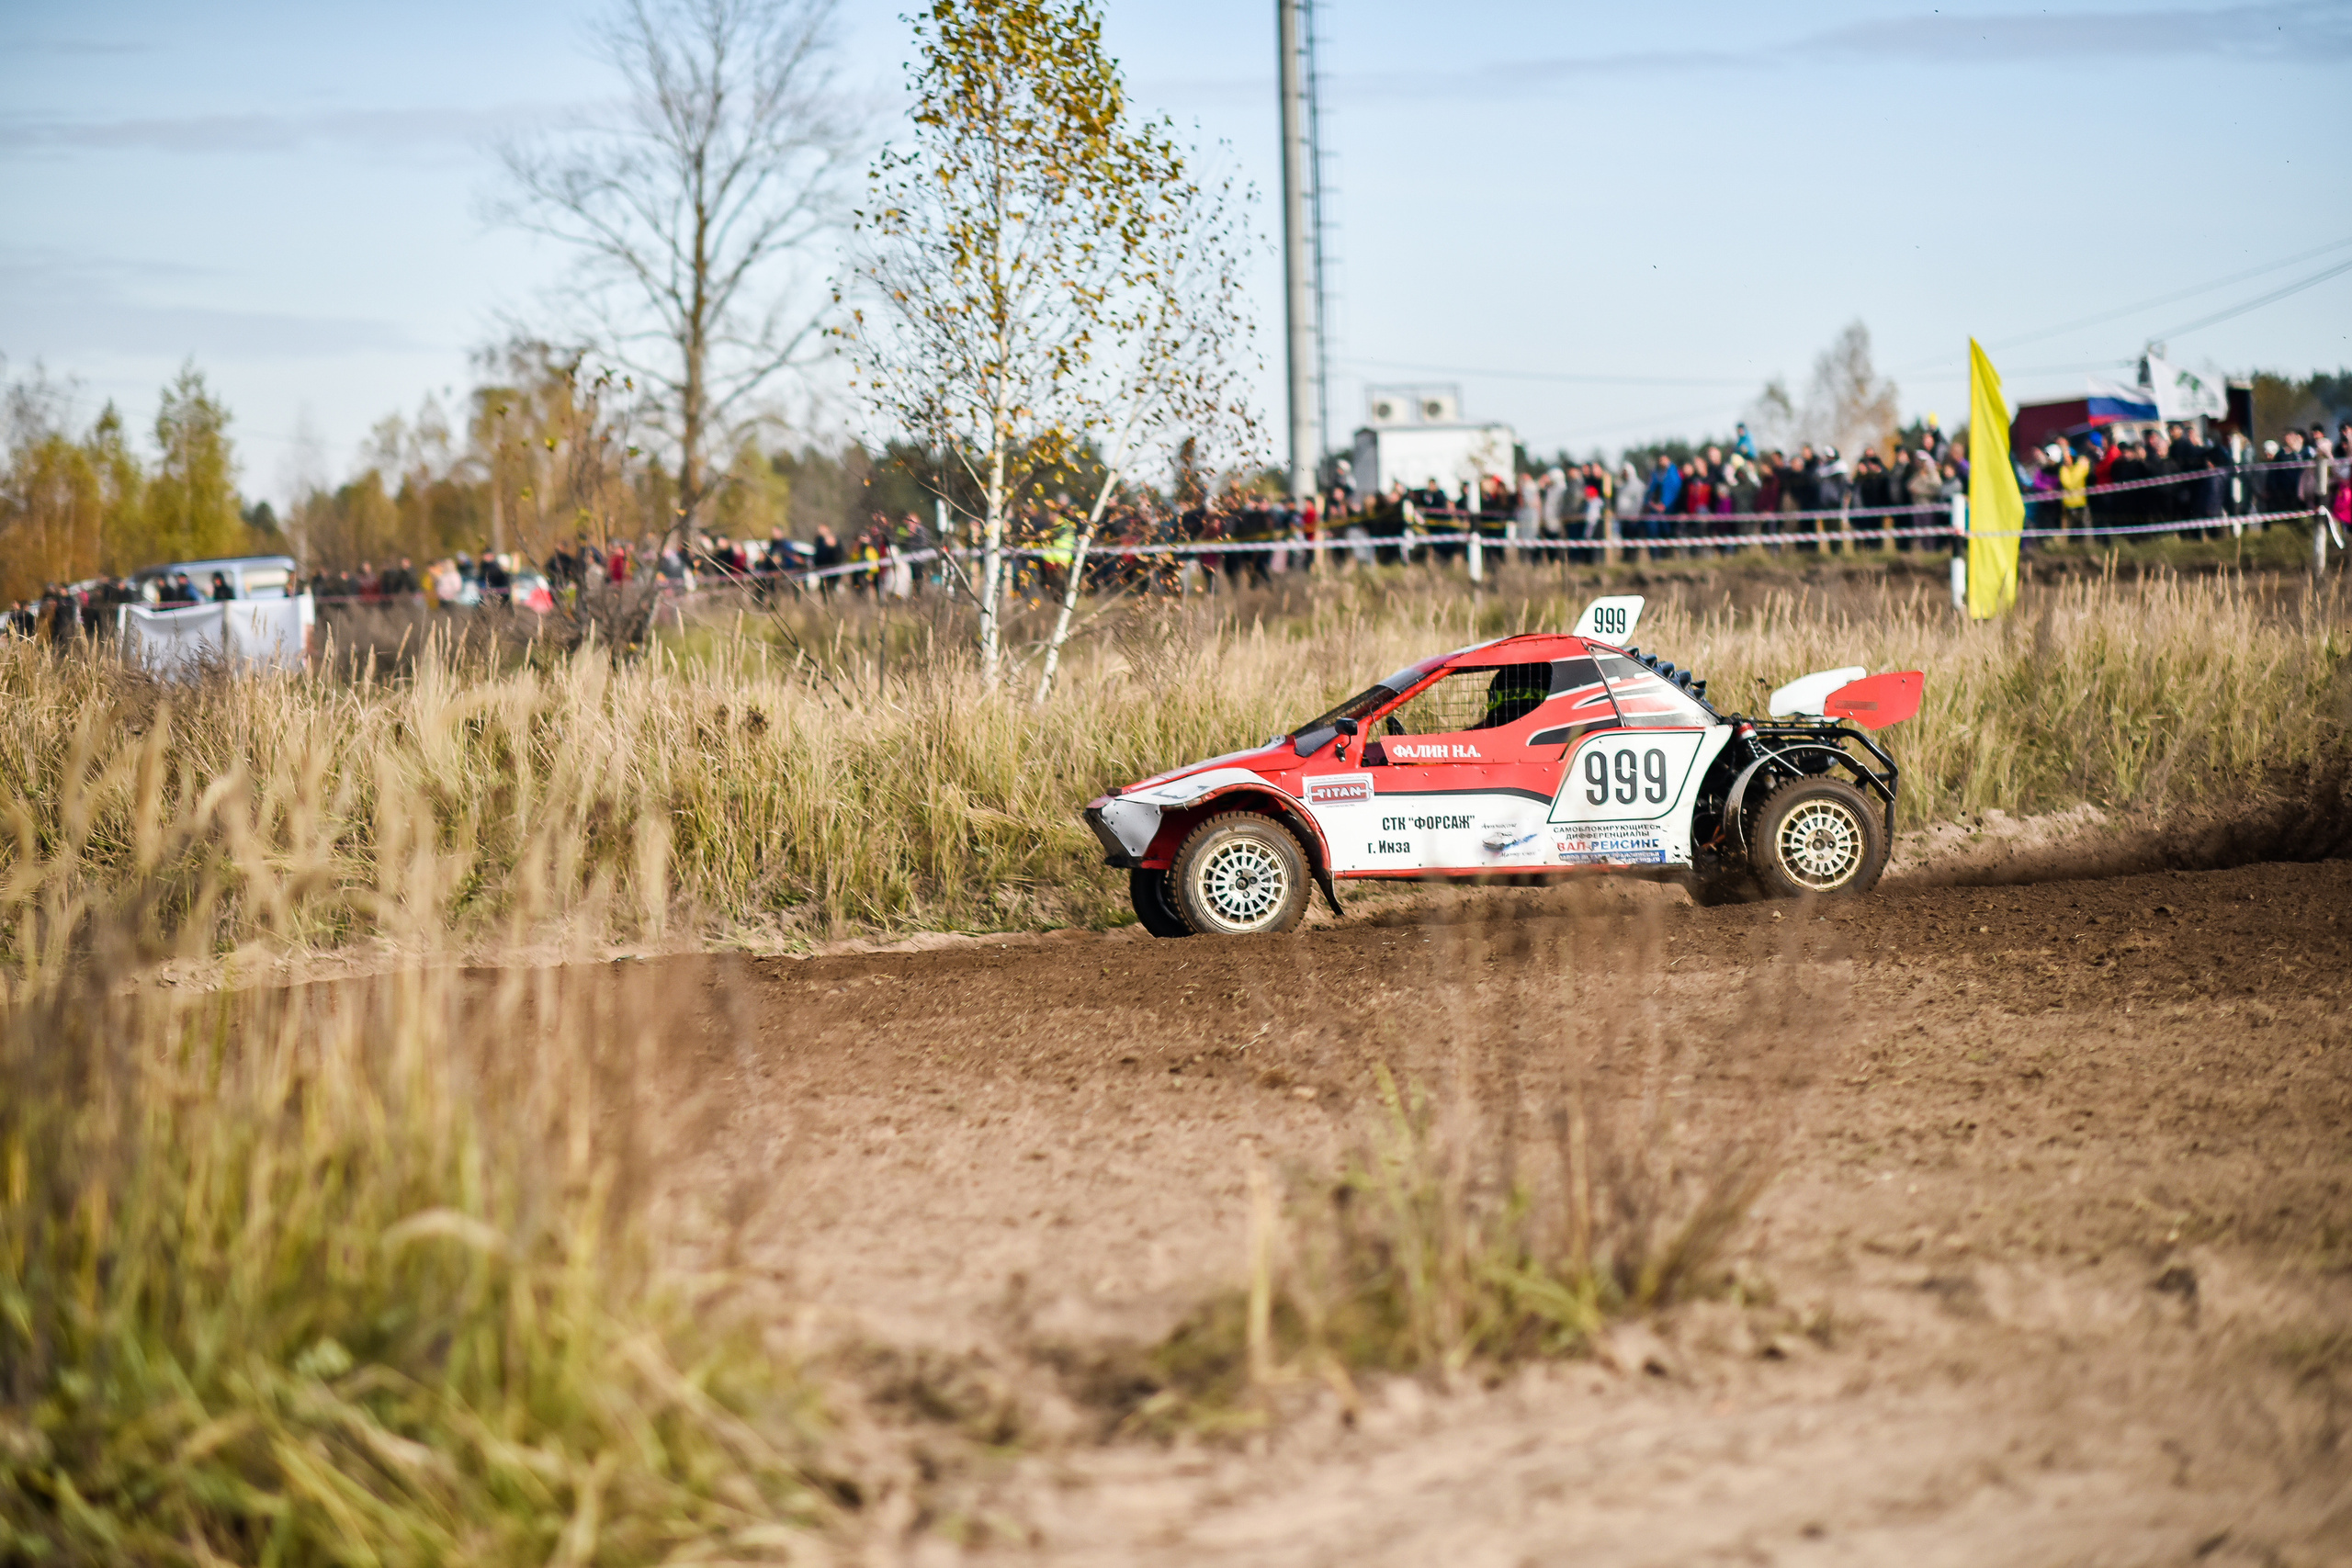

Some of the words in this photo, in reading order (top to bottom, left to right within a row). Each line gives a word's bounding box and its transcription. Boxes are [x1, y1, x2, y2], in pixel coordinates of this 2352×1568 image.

[1594, 606, 1626, 634] 999
[1393, 744, 1449, 758] ФАЛИН
[1452, 744, 1481, 758] Н.А.
[1585, 748, 1668, 807] 999
[1317, 785, 1362, 799] TITAN
[1382, 817, 1407, 830] СТК
[1553, 824, 1661, 833] САМОБЛОКИРУЮЩИЕСЯ
[1566, 830, 1650, 840] ДИФФЕРЕНЦИАЛЫ
[1367, 842, 1376, 854] г.
[1378, 840, 1411, 854] Инза
